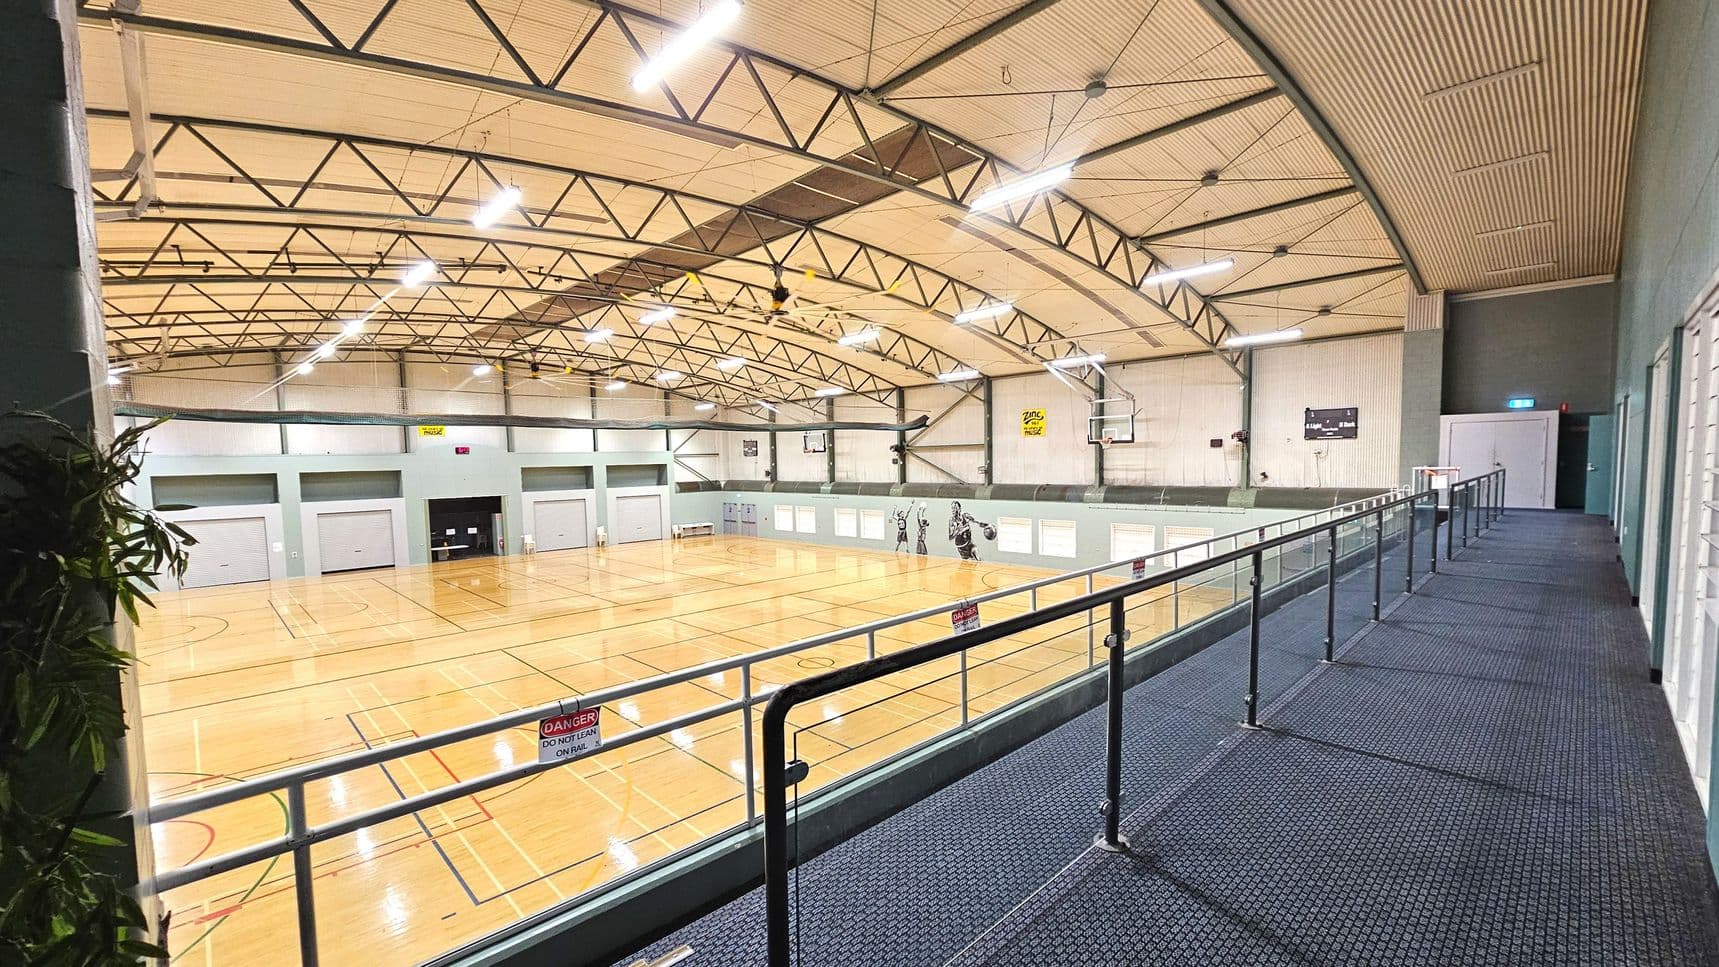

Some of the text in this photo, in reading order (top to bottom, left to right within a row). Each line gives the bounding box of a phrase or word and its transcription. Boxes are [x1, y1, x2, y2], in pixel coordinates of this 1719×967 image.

[953, 606, 977, 621] DANGER
[544, 712, 596, 733] DANGER
[542, 727, 597, 748] DO NOT LEAN
[556, 747, 570, 757] ON
[570, 742, 588, 754] RAIL
